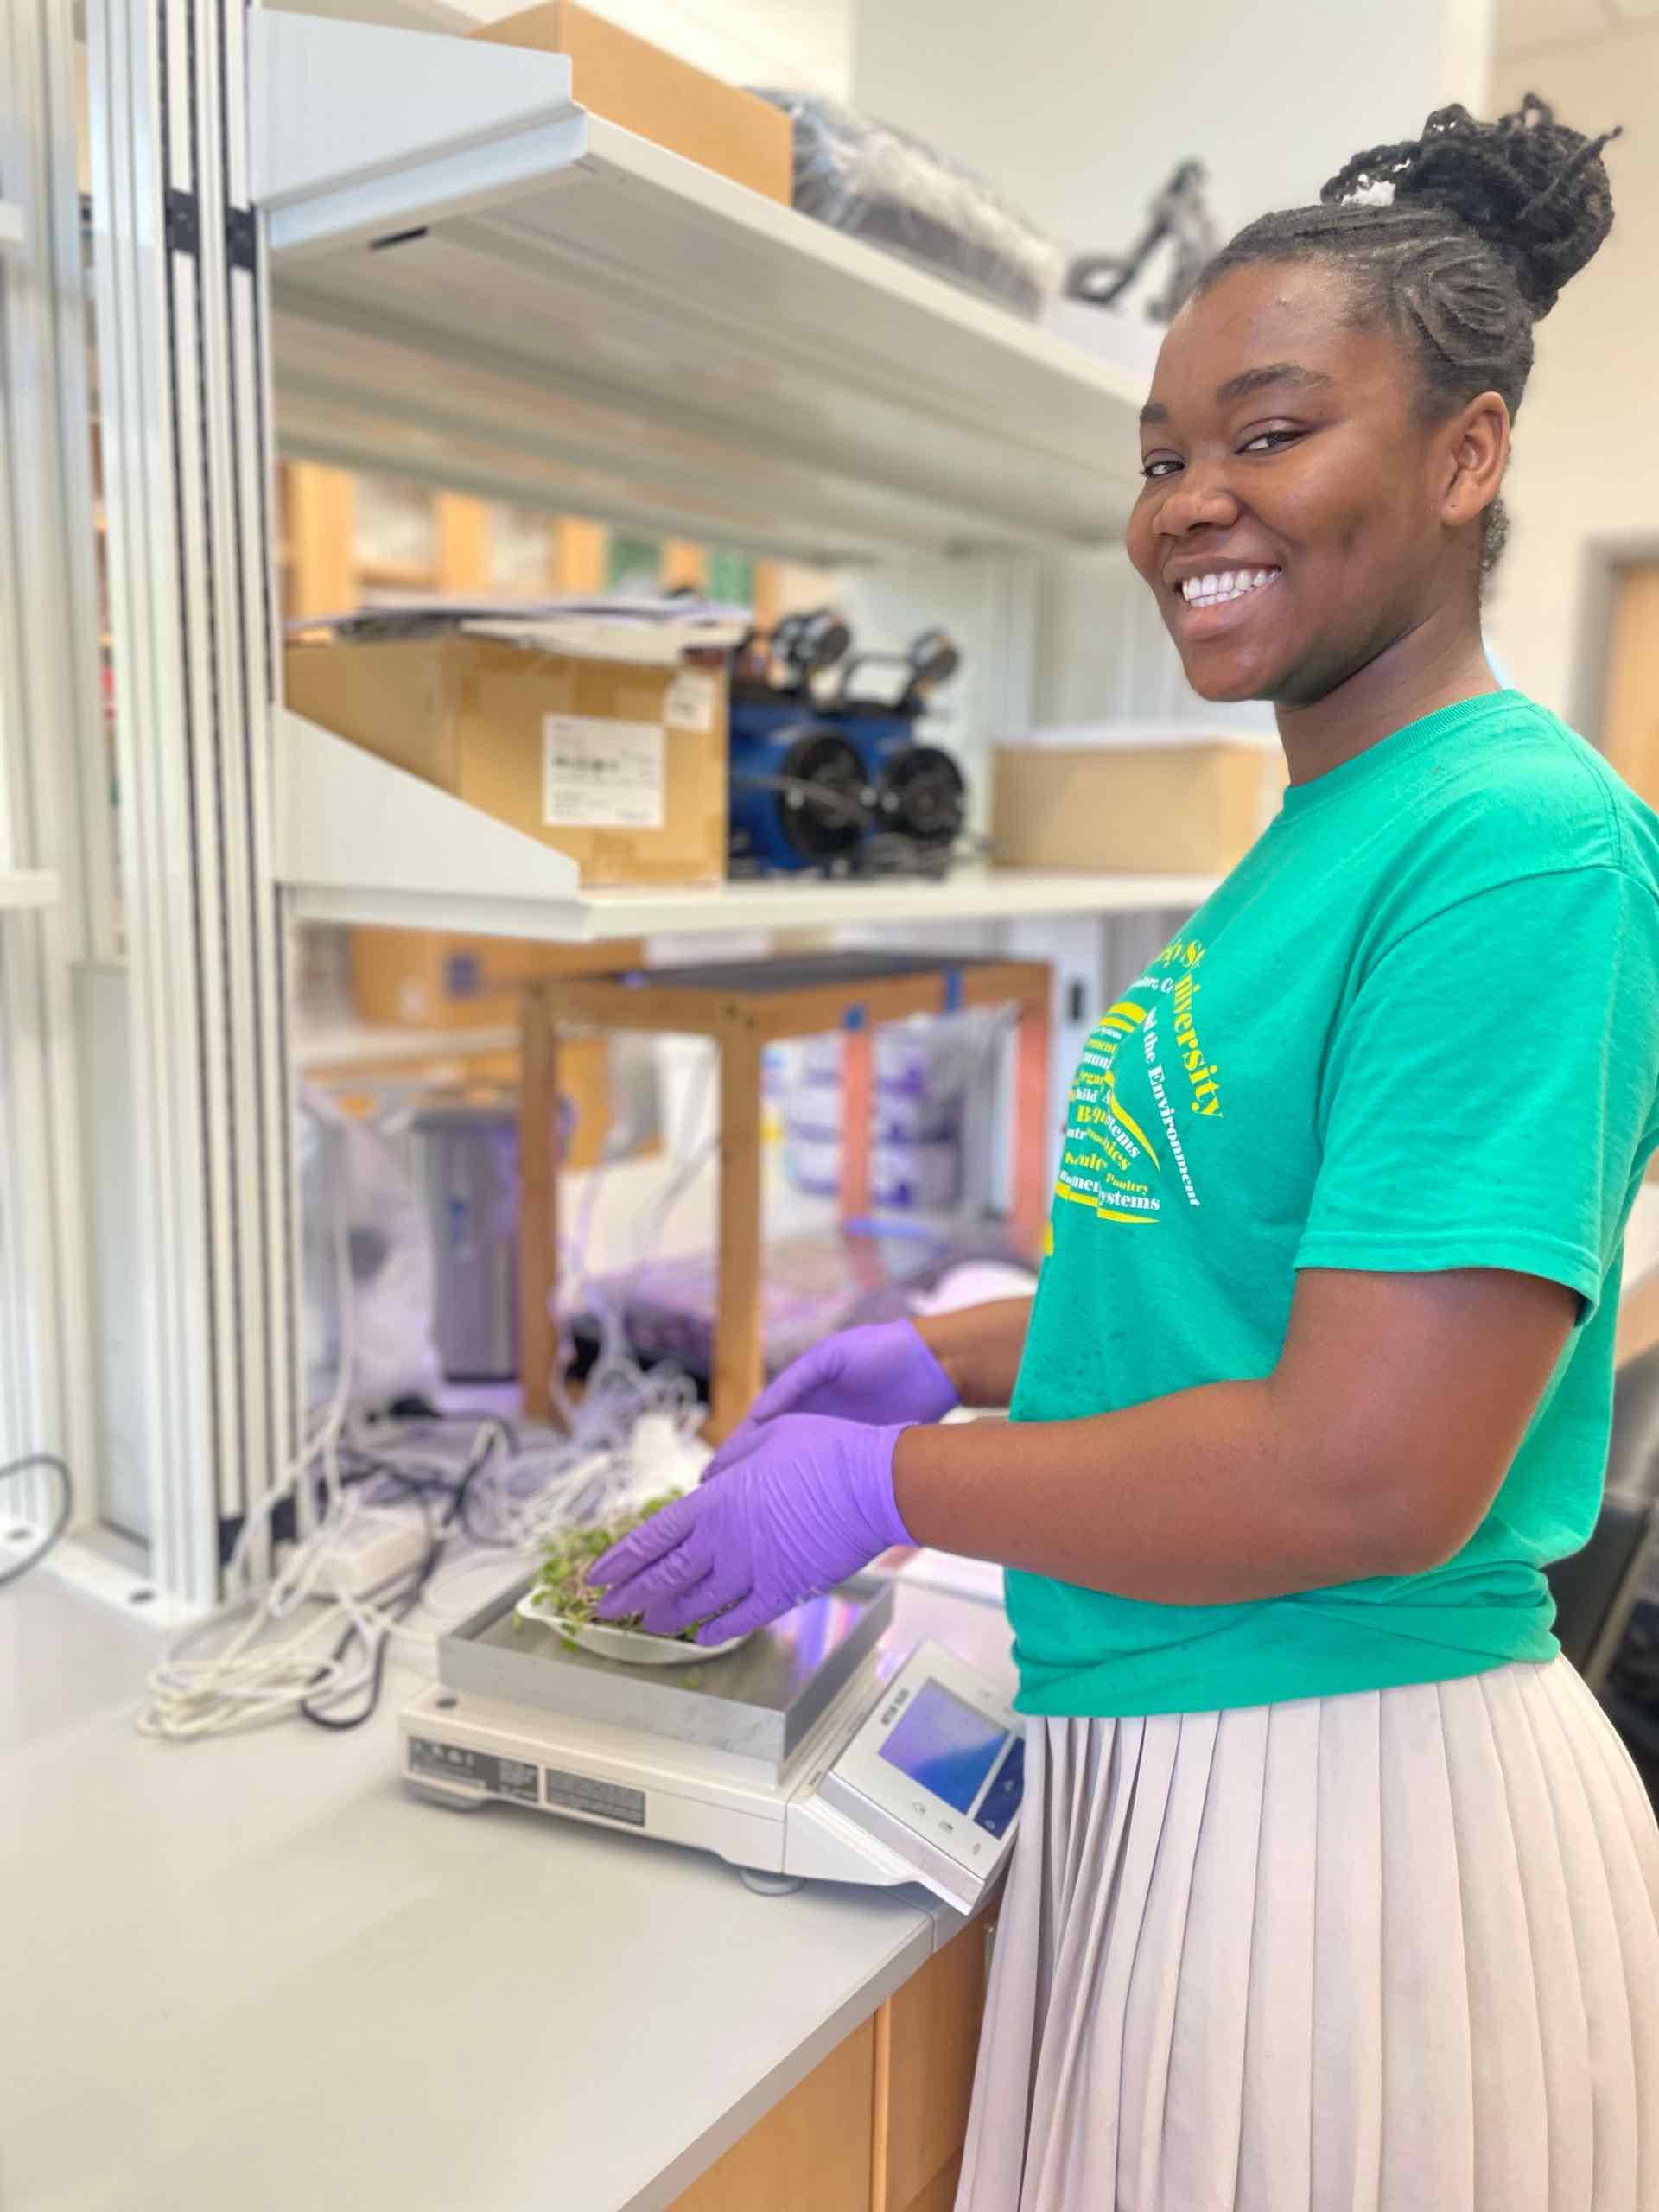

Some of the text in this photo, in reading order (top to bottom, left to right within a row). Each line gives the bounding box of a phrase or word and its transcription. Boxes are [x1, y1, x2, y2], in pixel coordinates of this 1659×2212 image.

[1142, 1033, 1159, 1064] the
[1147, 1064, 1201, 1209] Environment
[1098, 1191, 1160, 1211] ystems
